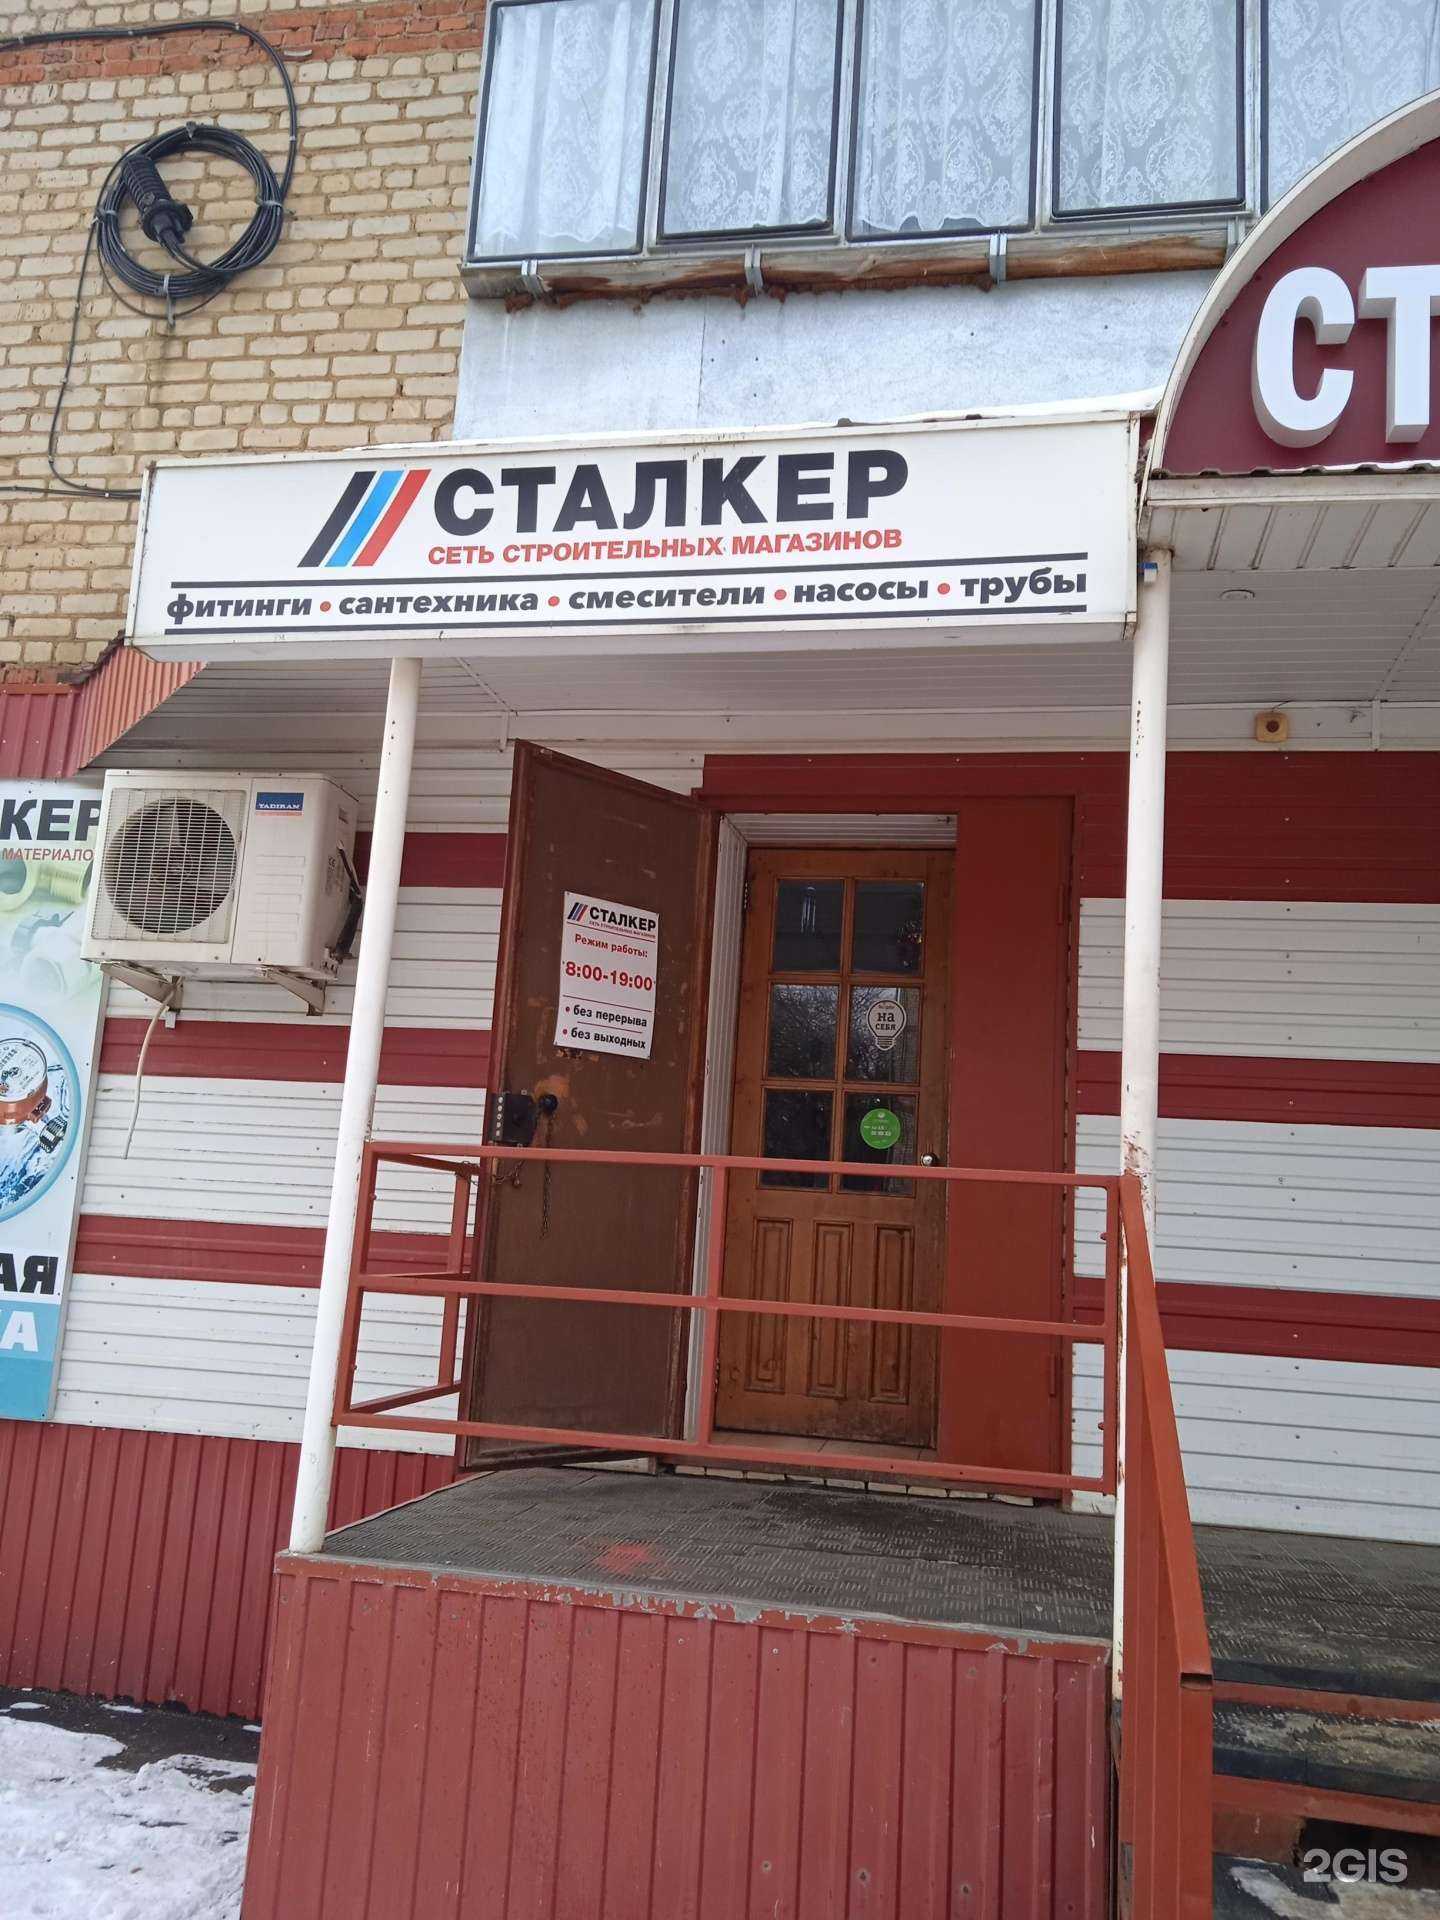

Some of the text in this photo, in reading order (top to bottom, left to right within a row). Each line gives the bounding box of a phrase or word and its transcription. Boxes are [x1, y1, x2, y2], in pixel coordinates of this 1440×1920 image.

[434, 449, 908, 536] СТАЛКЕР
[428, 528, 902, 566] СЕТЬ СТРОИТЕЛЬНЫХ МАГАЗИНОВ
[166, 567, 1086, 624] фитинги сантехника смесители насосы трубы
[589, 906, 656, 932] СТАЛКЕР
[575, 933, 648, 958] Режим работы:
[565, 961, 653, 991] 8:00-19:00
[573, 1005, 647, 1027] без перерыва
[571, 1027, 646, 1049] без выходных
[0, 1309, 39, 1353] А
